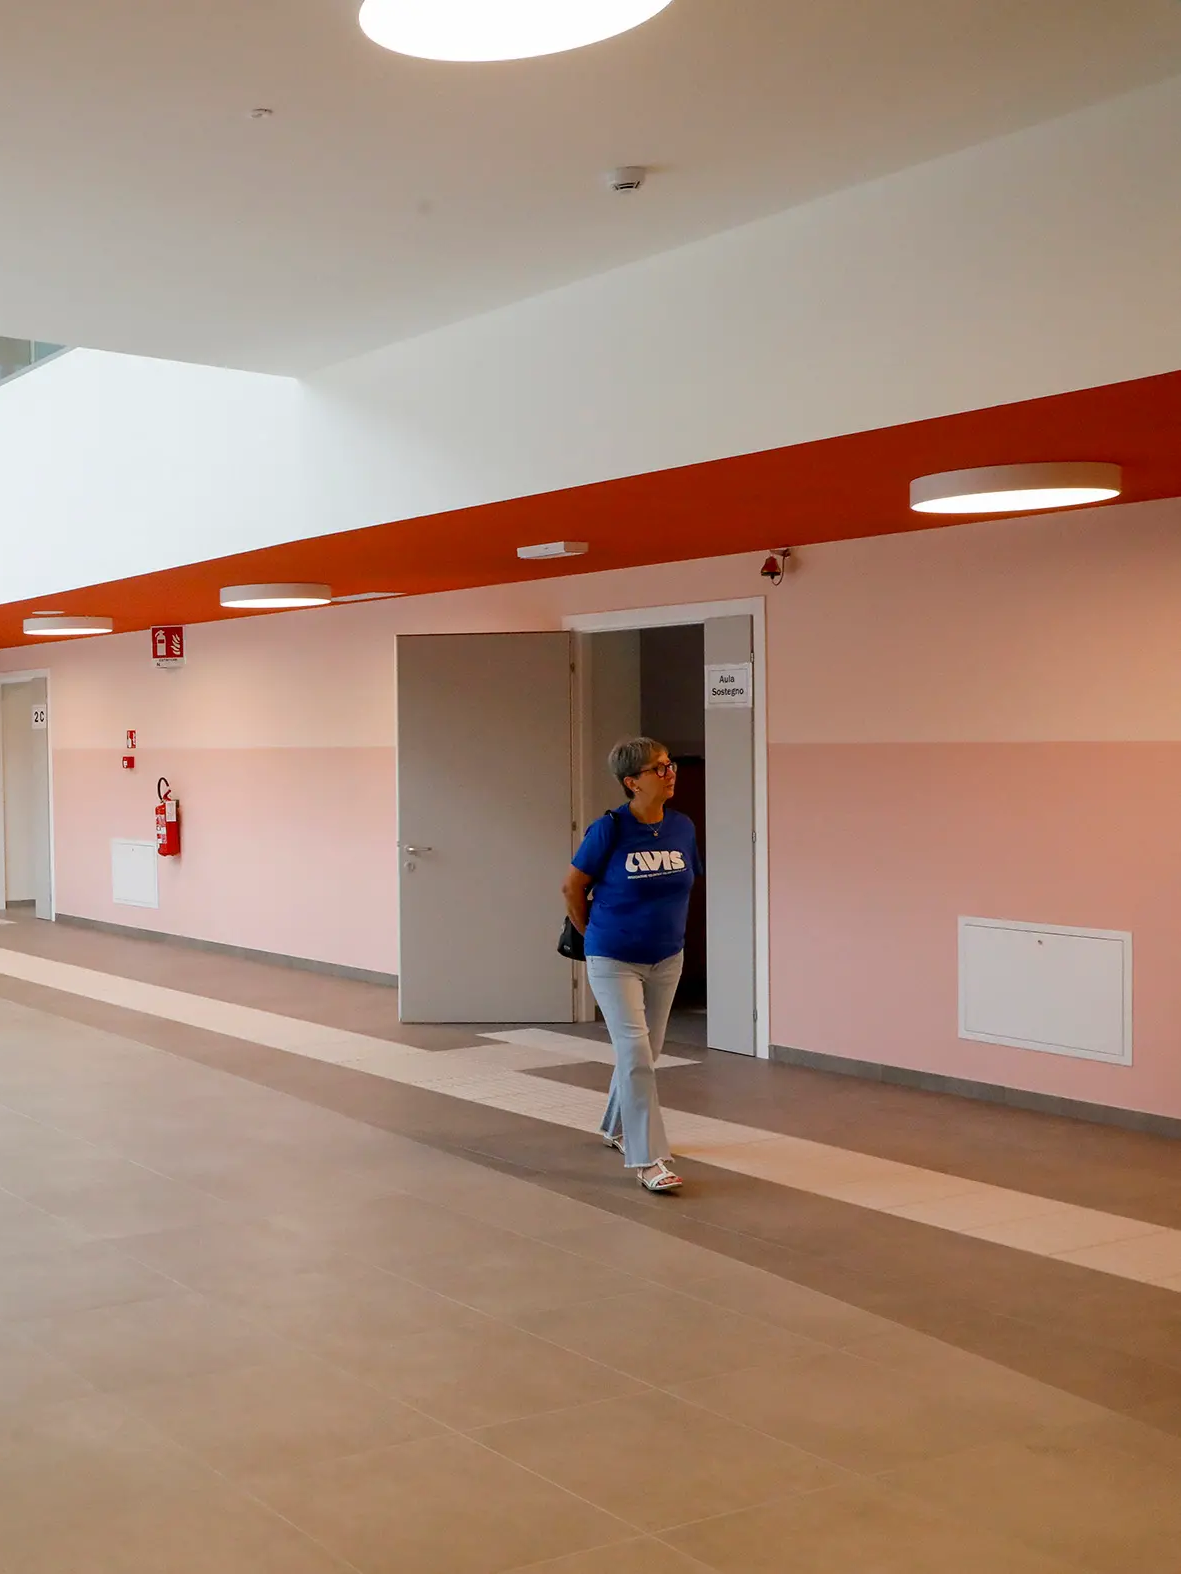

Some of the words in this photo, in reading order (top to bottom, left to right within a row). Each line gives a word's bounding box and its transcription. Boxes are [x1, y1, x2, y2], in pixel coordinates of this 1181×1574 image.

[719, 675, 735, 683] Aula
[711, 687, 744, 697] Sostegno
[34, 710, 45, 723] 2C
[625, 850, 686, 873] AVIS
